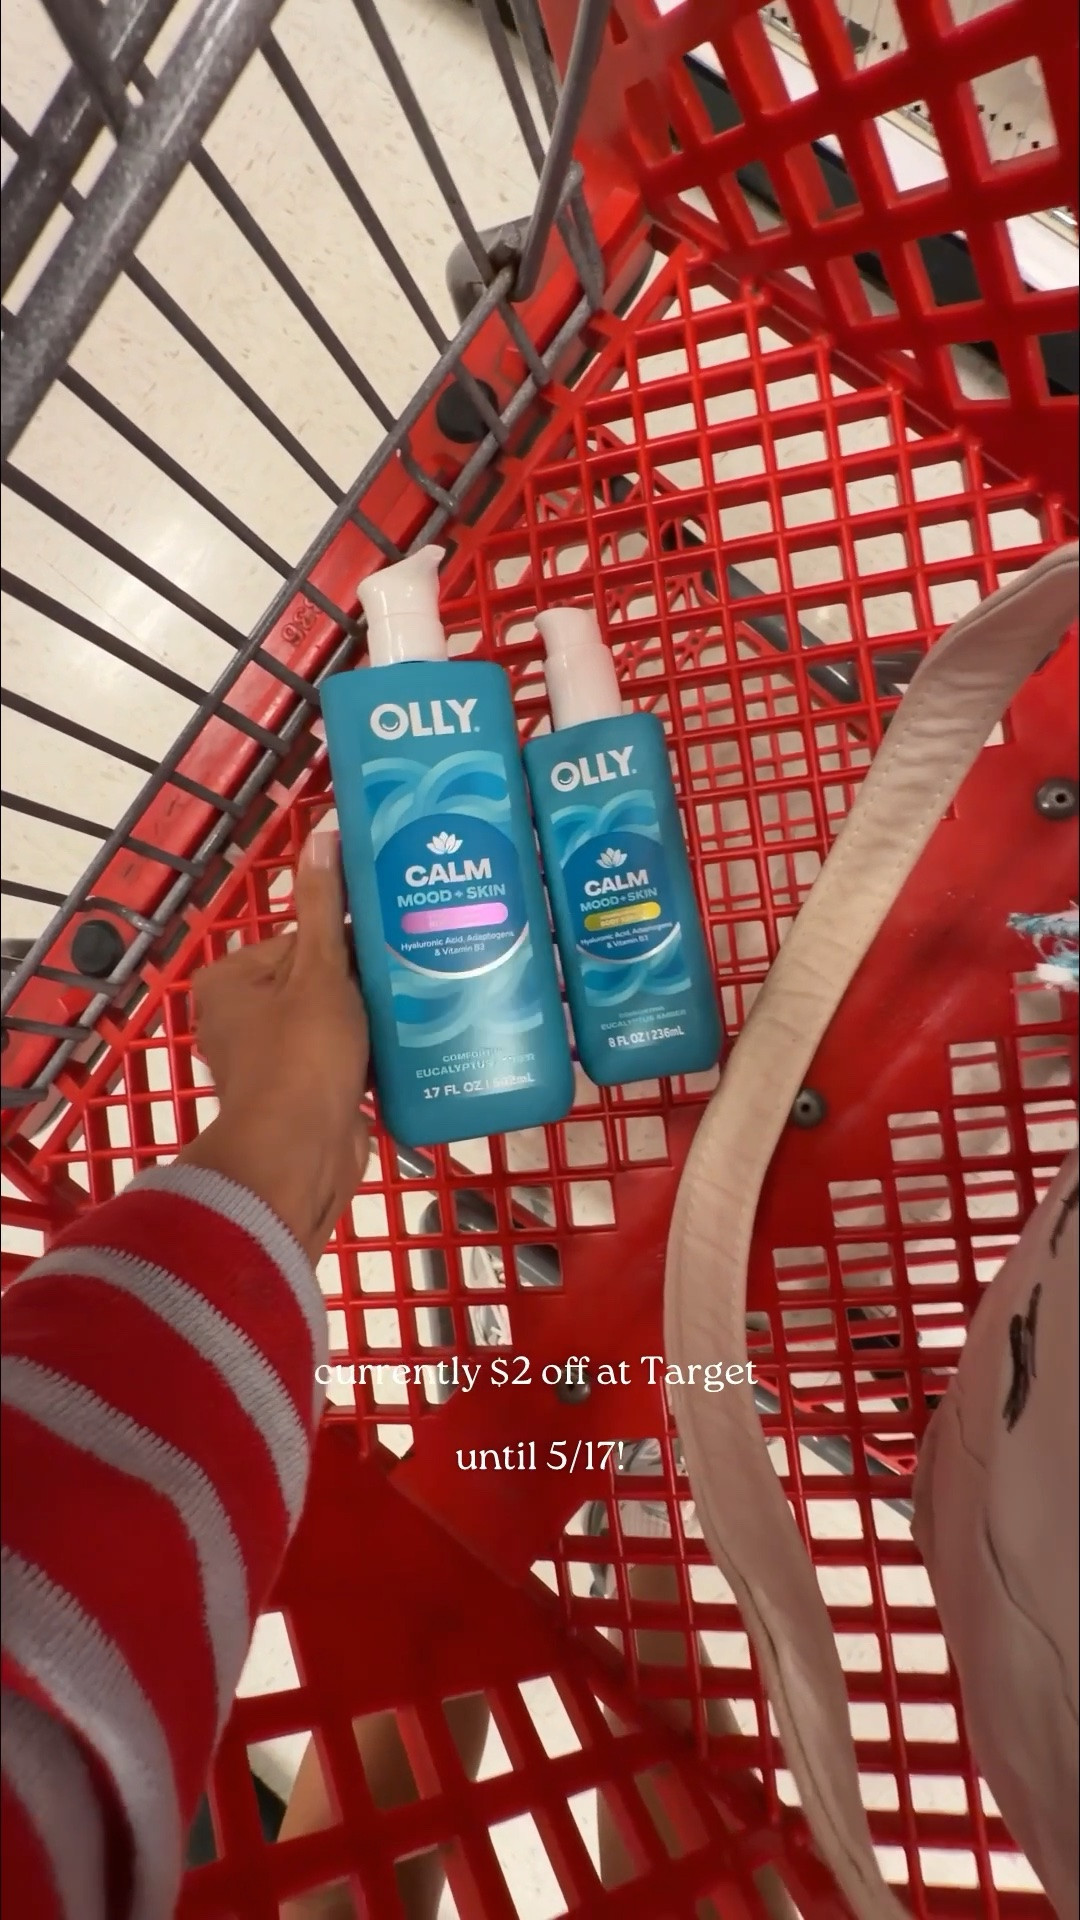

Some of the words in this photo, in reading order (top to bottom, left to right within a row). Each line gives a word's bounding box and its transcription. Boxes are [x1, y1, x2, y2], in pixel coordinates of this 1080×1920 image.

[405, 858, 492, 887] CALM
[584, 869, 650, 896] CALM
[397, 889, 452, 908] MOOD
[466, 884, 506, 900] SKIN
[580, 896, 619, 912] MOOD
[627, 887, 658, 902] SKIN
[401, 938, 443, 952] Hyaluronic
[434, 949, 441, 957] &
[442, 945, 472, 955] Vitamin
[608, 1037, 616, 1048] 8
[617, 1035, 629, 1046] FL
[630, 1031, 645, 1044] OZ
[652, 1025, 685, 1041] 236mL
[424, 1086, 440, 1099] 17
[444, 1084, 461, 1096] FL
[463, 1080, 482, 1092] OZ
